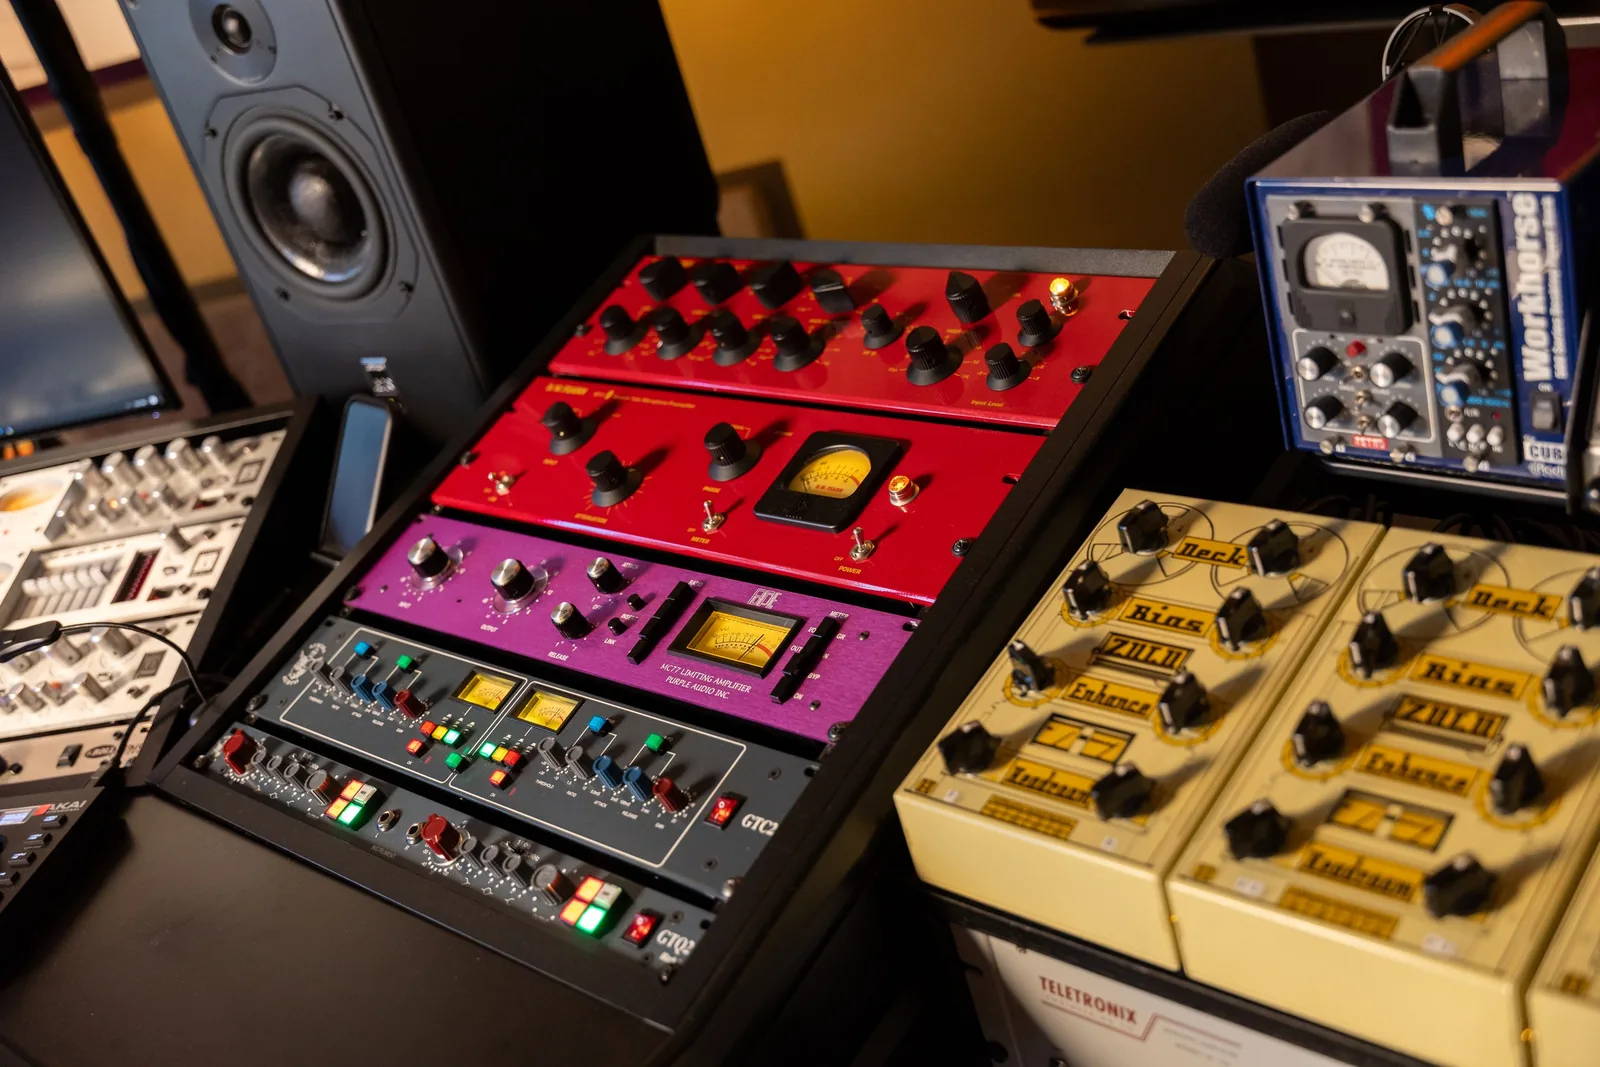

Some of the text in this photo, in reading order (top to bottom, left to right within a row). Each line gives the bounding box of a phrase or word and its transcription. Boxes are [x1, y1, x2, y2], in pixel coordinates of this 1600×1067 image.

[1512, 192, 1552, 381] Workhorse
[838, 565, 862, 575] POWER
[829, 610, 849, 619] METER
[1125, 604, 1204, 633] Bias
[604, 637, 617, 646] LINK
[547, 651, 569, 662] RELEASE
[660, 663, 752, 693] MC77 LIMITING AMPLIFIER
[665, 675, 730, 699] PURPLE AUDIO INC.
[793, 692, 804, 700] ON
[1069, 682, 1151, 716] Enhance
[48, 800, 87, 810] AKAI
[741, 813, 779, 836] GTC2
[1039, 976, 1138, 1025] TELETRONIX
